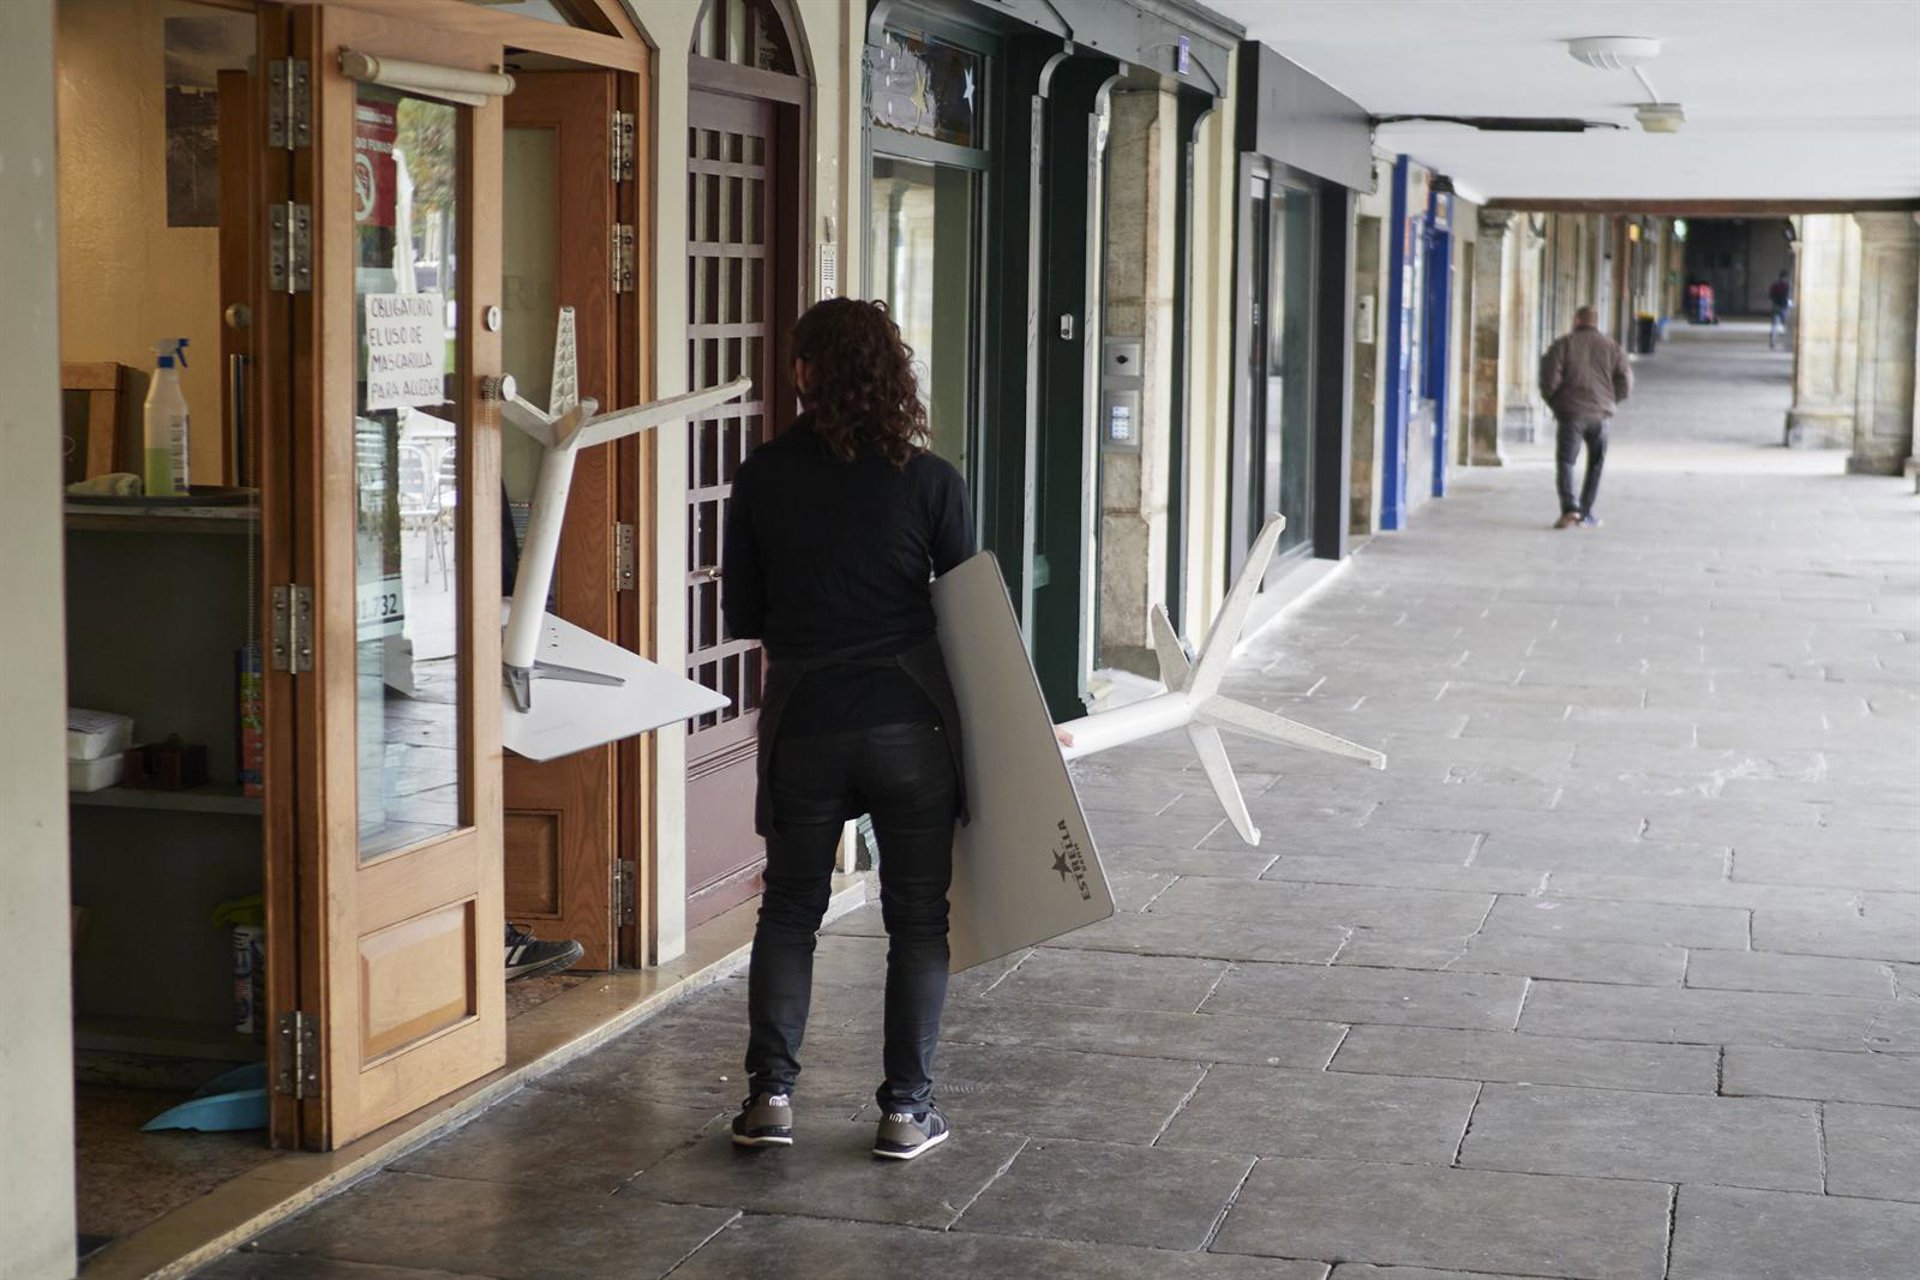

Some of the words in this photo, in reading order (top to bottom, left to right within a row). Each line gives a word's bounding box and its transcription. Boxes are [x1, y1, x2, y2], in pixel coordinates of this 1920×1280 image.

[371, 297, 433, 318] OBLIGATORIO
[369, 328, 383, 347] EL
[385, 326, 406, 345] USO
[410, 325, 423, 344] DE
[371, 352, 433, 373] MASCARILLA
[371, 382, 399, 402] PARA
[403, 377, 441, 397] ACCEDER
[1057, 819, 1091, 901] ESTRELLA
